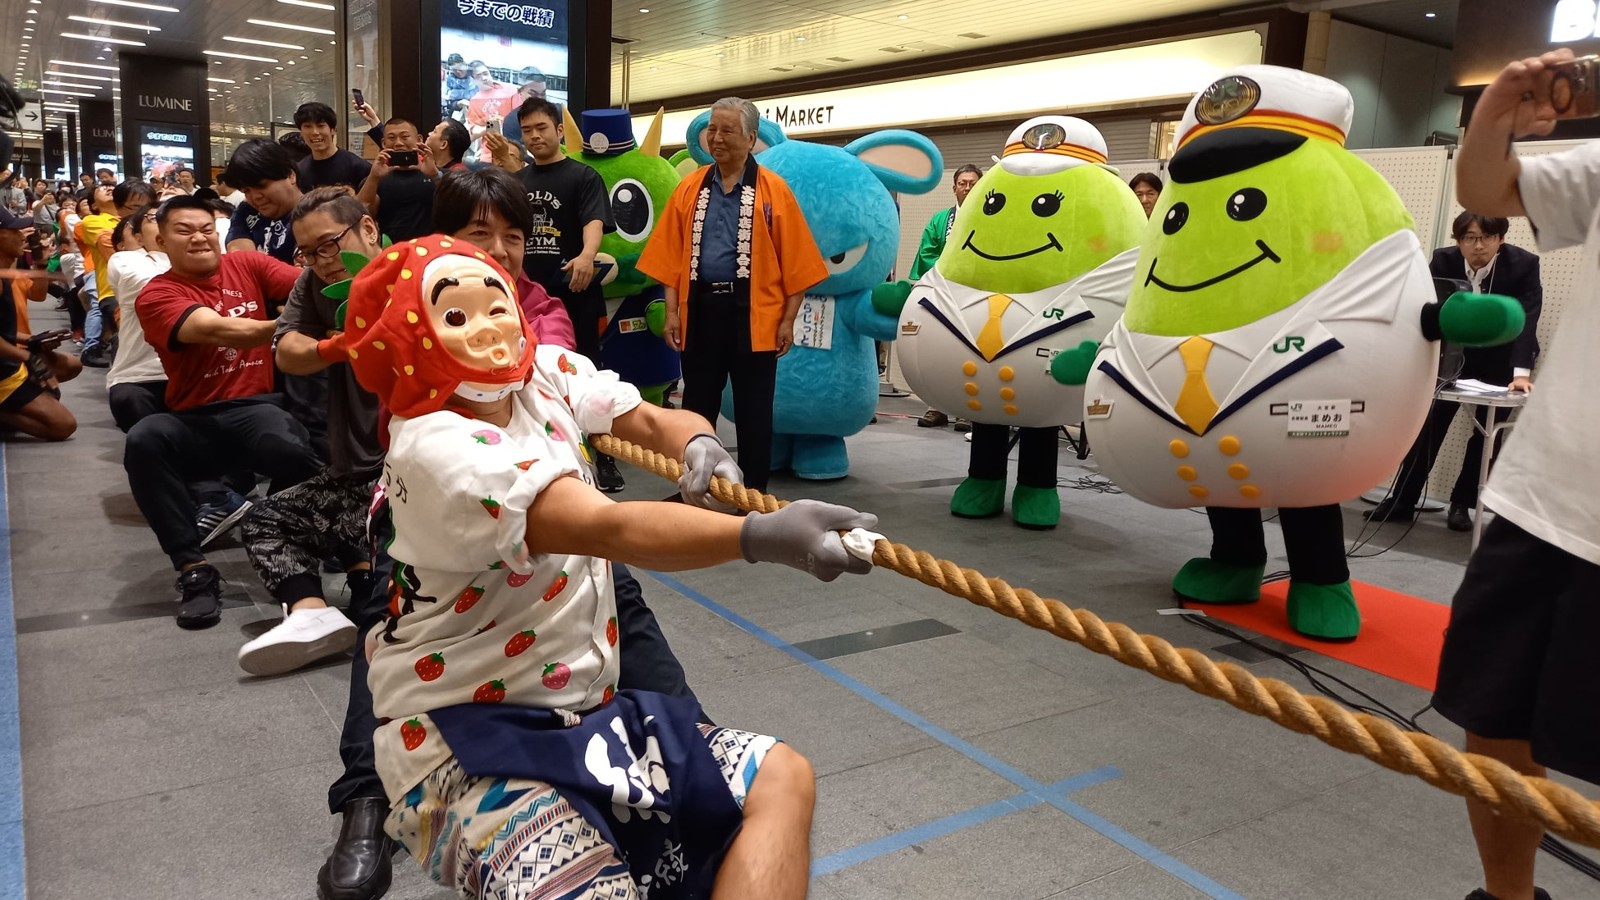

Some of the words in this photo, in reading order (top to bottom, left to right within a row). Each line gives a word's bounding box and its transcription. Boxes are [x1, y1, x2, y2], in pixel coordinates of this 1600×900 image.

[457, 0, 554, 28] 今までの戦績
[139, 94, 192, 111] LUMINE
[775, 105, 834, 128] MARKET
[527, 190, 562, 209] OLD'S
[690, 187, 710, 280] 大宮商店街連合会
[736, 185, 755, 278] 大宮商店街連合会
[526, 236, 556, 246] GYM
[228, 300, 259, 318] D'S
[1043, 308, 1064, 320] JR
[1272, 336, 1306, 354] JR
[1311, 413, 1343, 423] まめお
